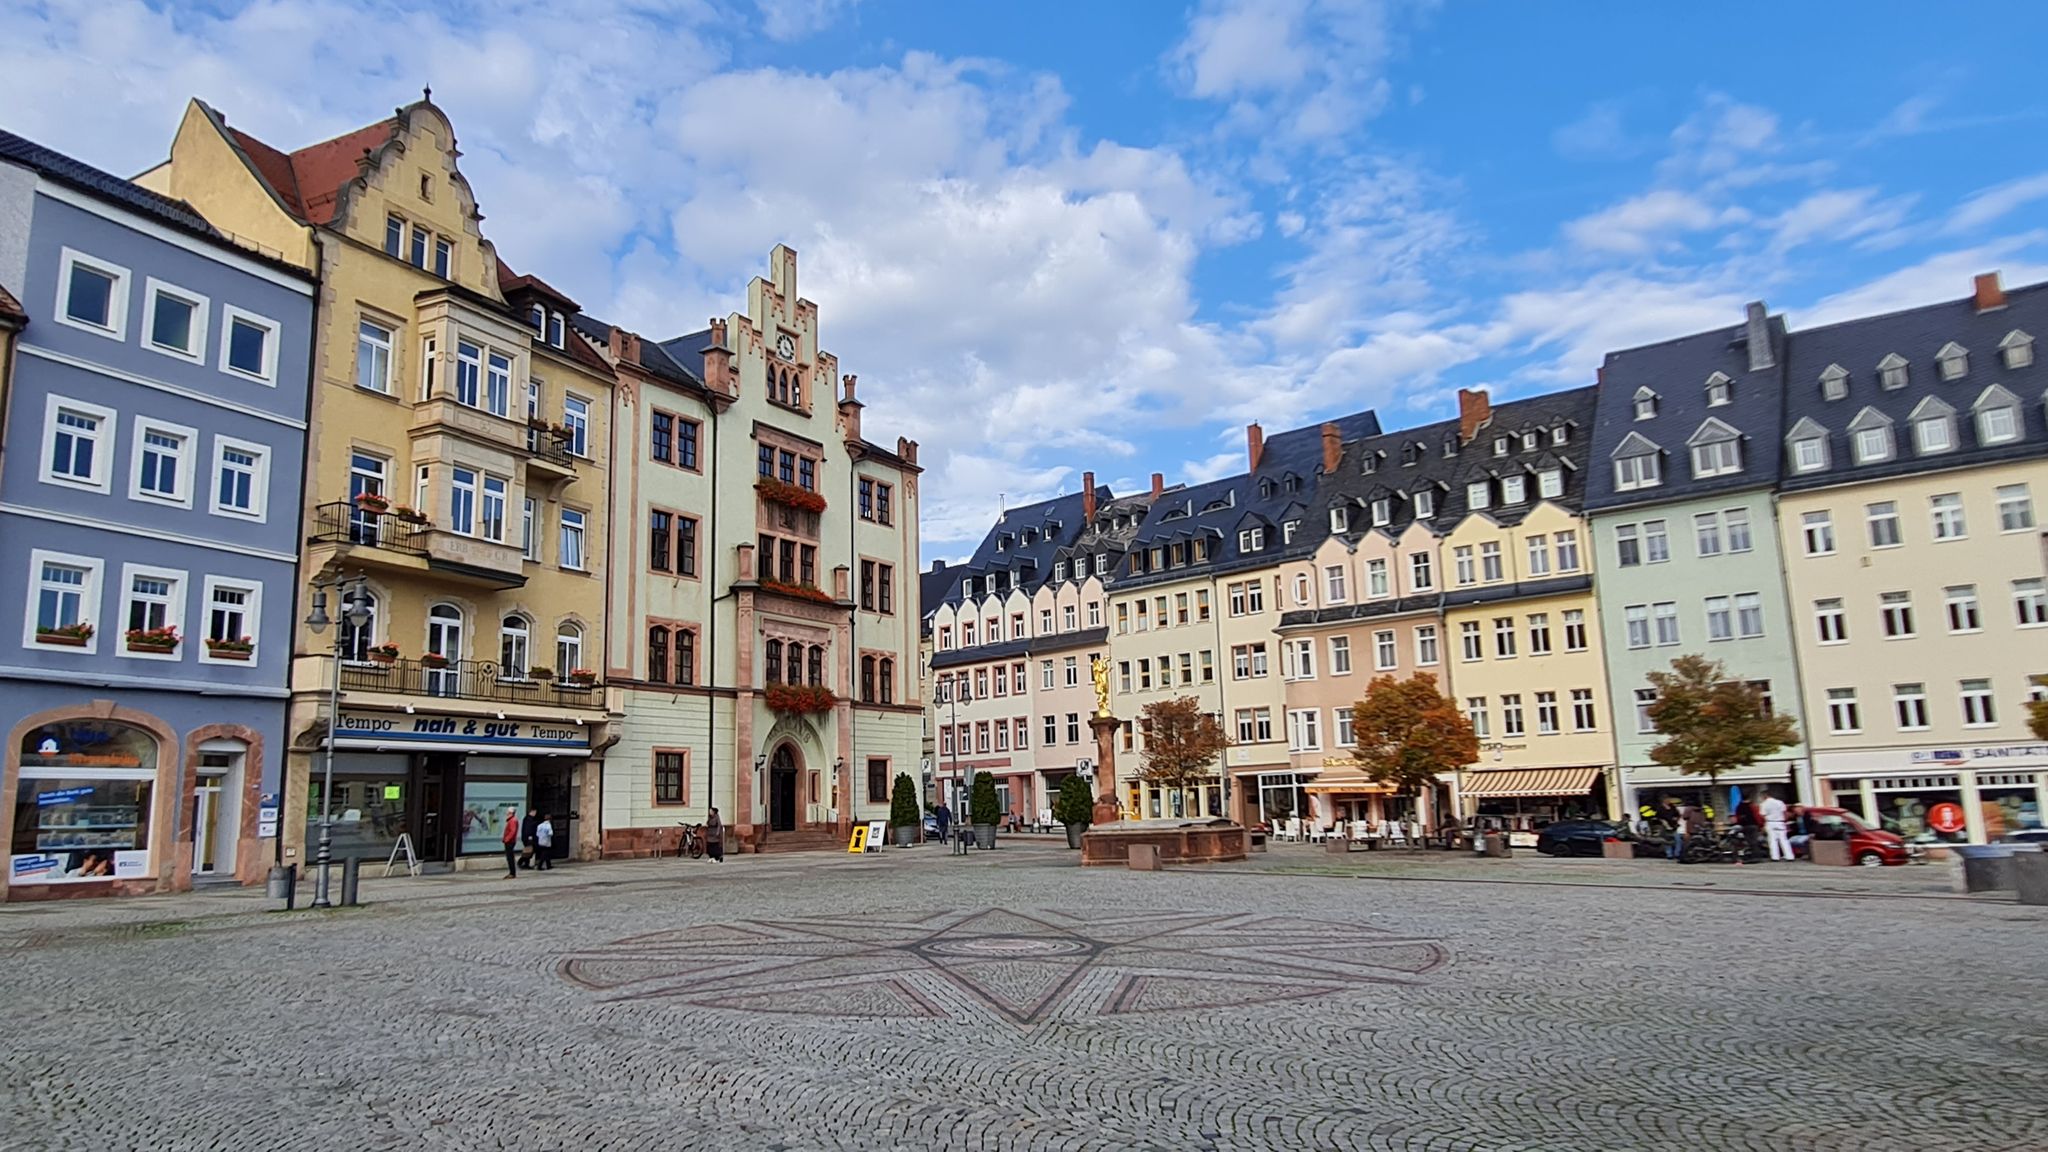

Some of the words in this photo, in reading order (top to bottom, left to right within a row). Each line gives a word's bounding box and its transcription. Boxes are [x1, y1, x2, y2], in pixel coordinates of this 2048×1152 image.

[335, 713, 399, 732] Tempo
[413, 716, 456, 735] nah
[462, 719, 477, 736] &
[483, 719, 520, 739] gut
[531, 724, 579, 741] Tempo
